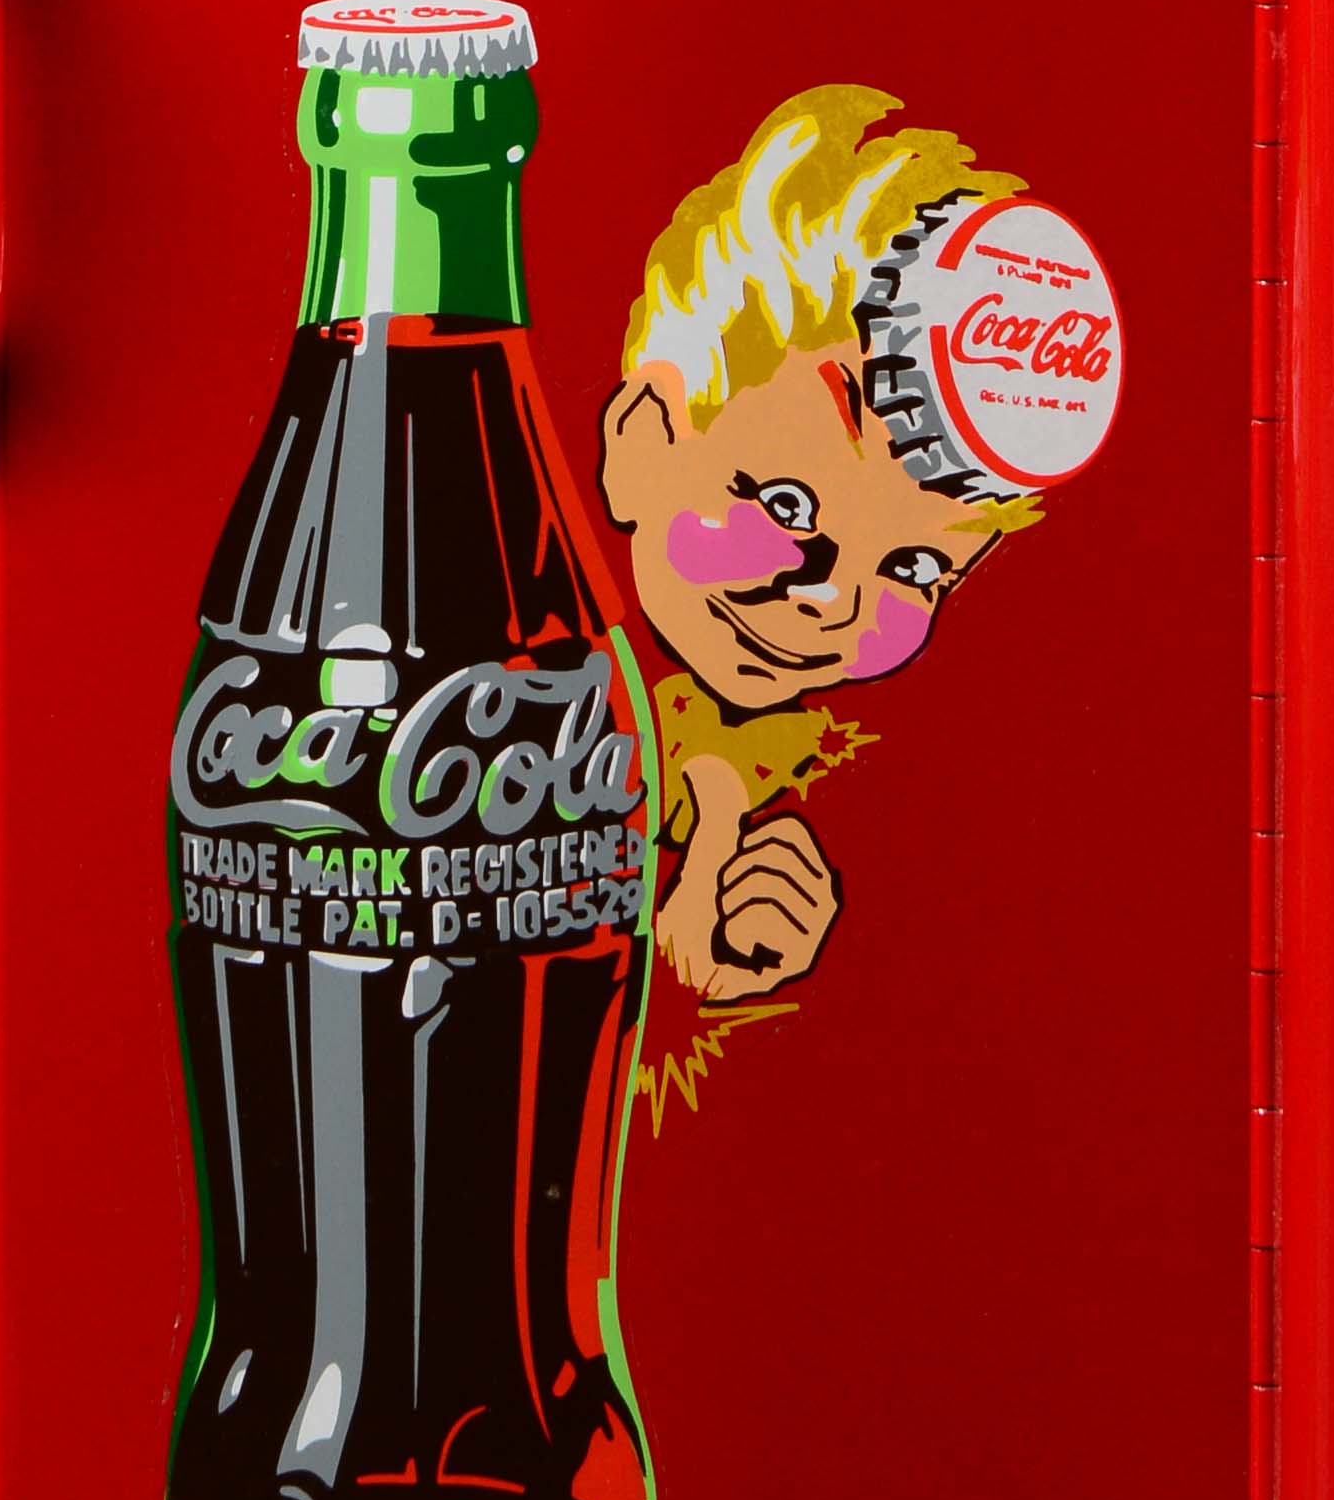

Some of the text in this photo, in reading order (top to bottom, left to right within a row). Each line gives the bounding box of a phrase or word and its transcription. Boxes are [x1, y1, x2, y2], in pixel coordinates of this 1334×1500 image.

[950, 293, 1113, 383] Coca-Cola
[170, 650, 647, 838] Coca-Cola
[180, 824, 647, 898] TRADE MARK REGISTERED
[184, 879, 302, 947] BOTTLE
[323, 899, 415, 948] PAT.
